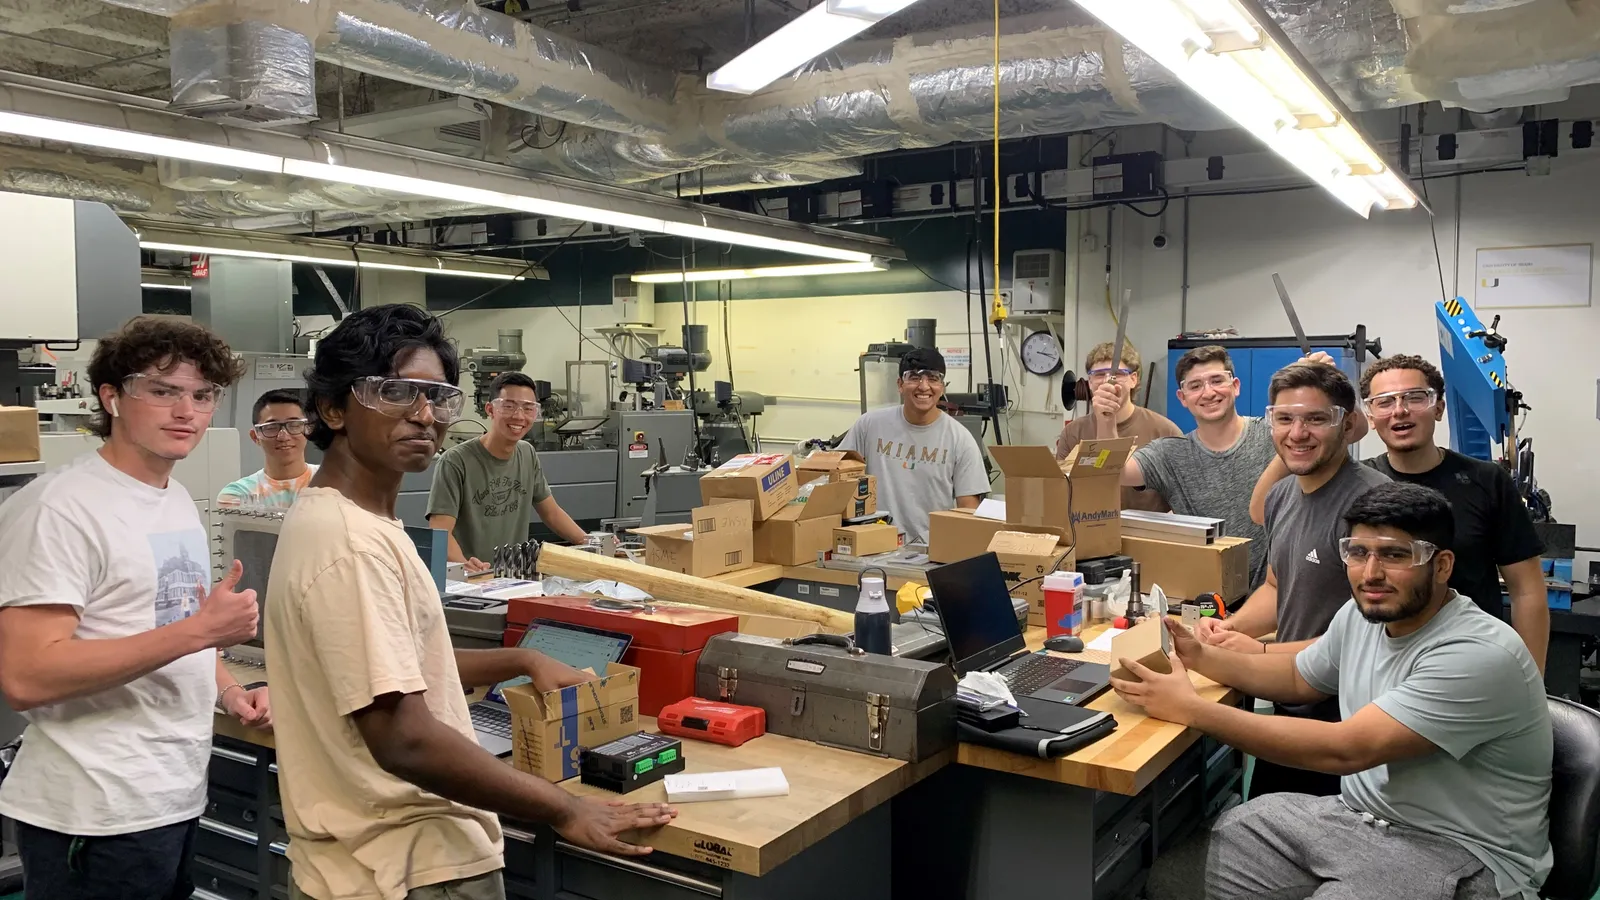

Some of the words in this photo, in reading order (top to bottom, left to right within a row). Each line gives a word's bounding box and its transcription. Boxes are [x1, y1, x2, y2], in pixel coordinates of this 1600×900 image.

[876, 438, 948, 464] MIAMI
[767, 461, 785, 480] ULINE
[1081, 510, 1118, 521] AndyMark
[651, 548, 677, 565] ASME
[694, 840, 733, 857] GLOBAL
